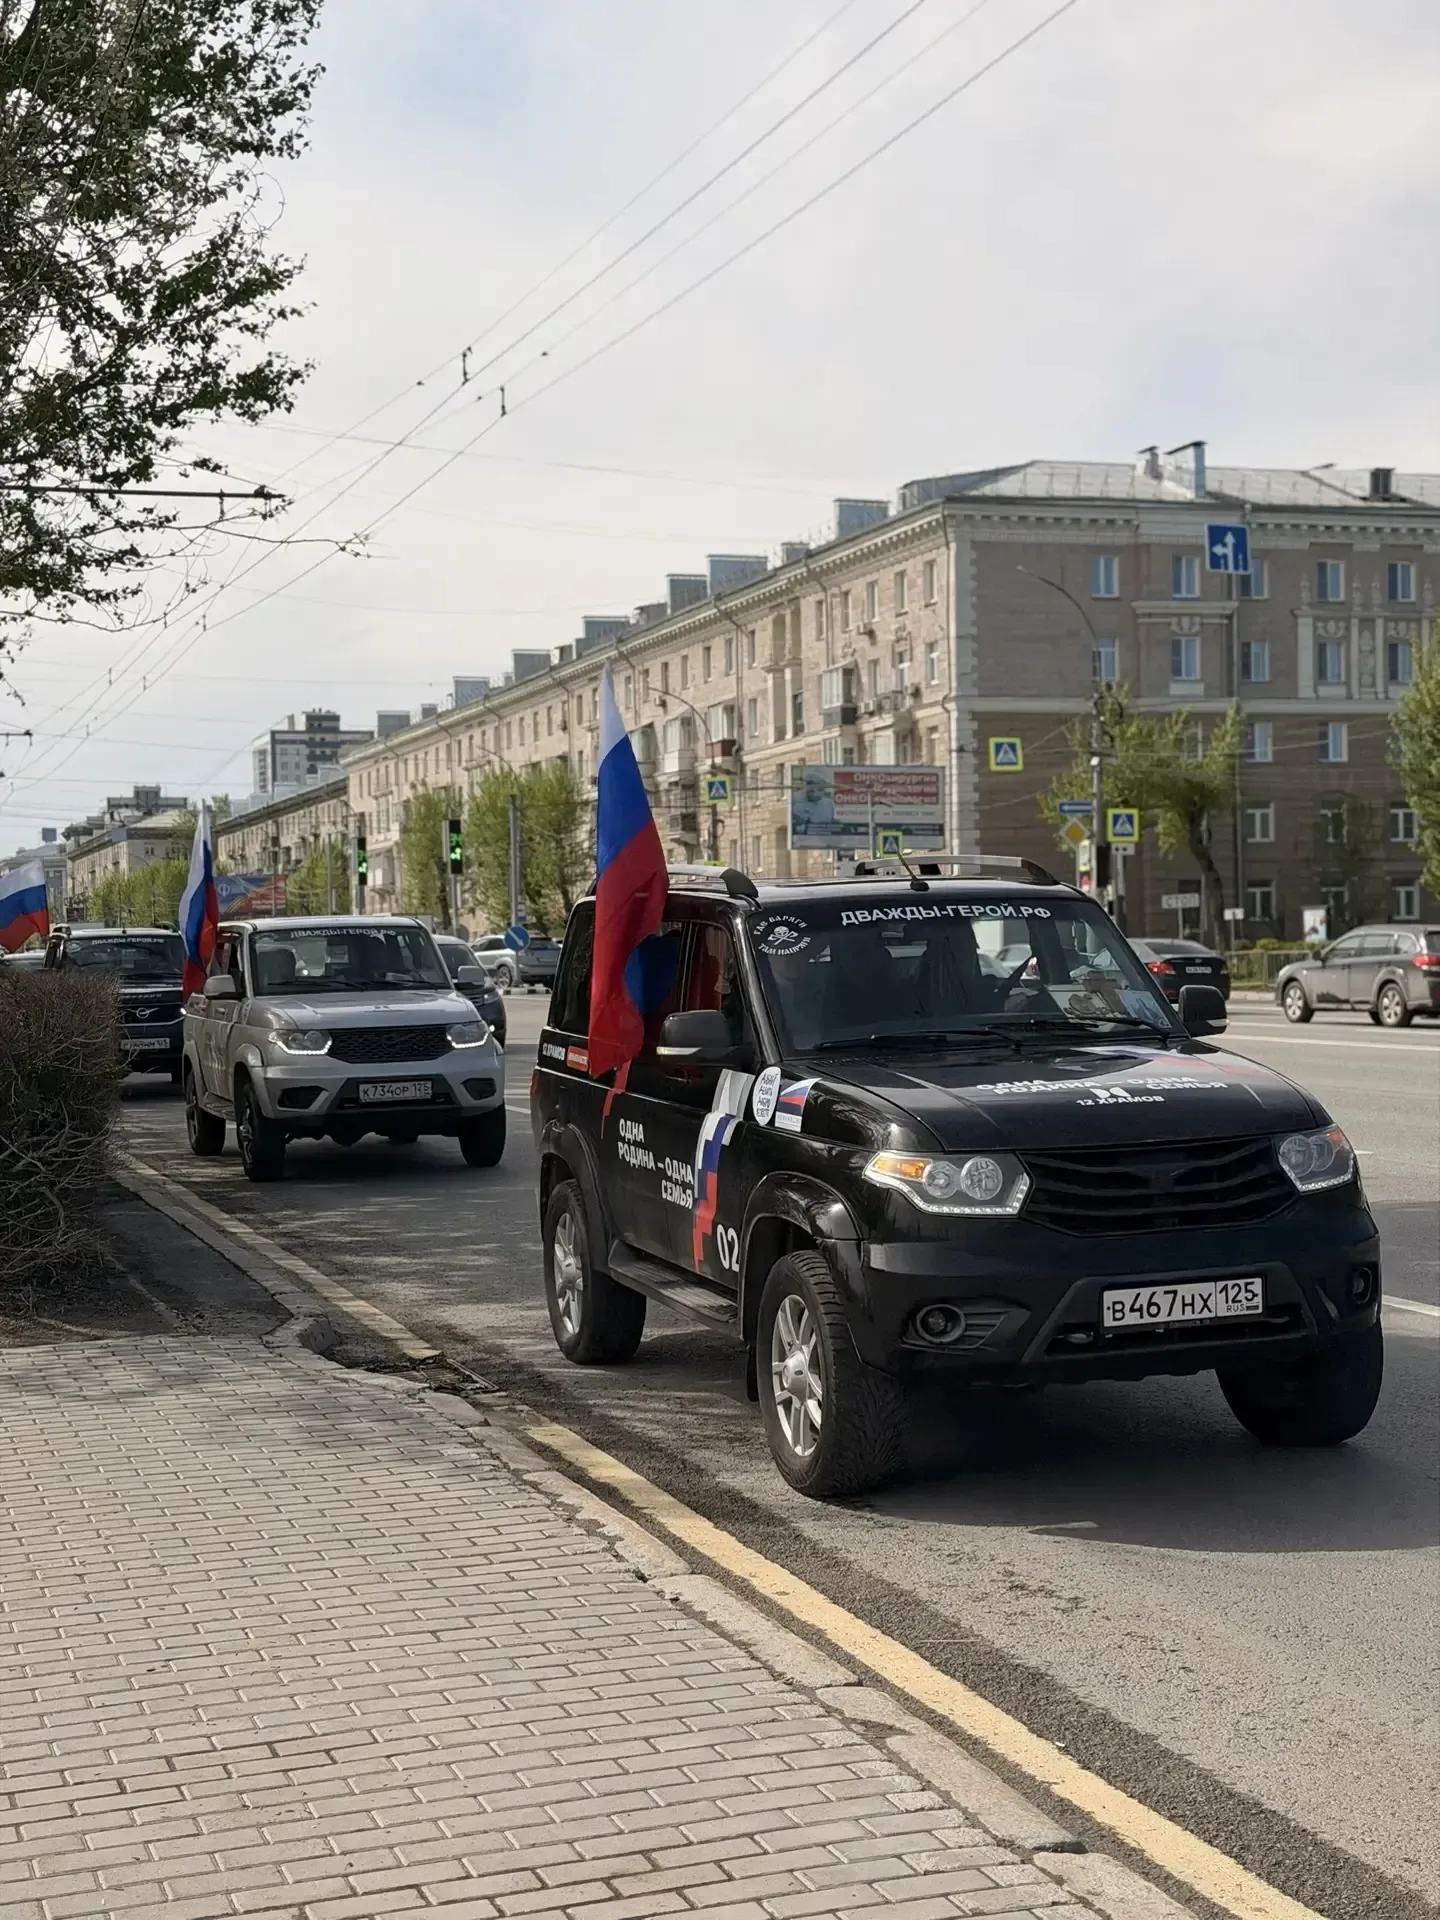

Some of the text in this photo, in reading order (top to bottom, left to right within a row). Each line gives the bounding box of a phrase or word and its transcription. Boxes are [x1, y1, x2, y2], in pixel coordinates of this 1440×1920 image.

[840, 902, 1051, 926] ДВАЖДЫ-ГЕРОЙ.РФ
[993, 1081, 1101, 1095] РОДИНА
[1127, 1076, 1199, 1085] ОДНА
[1145, 1082, 1228, 1090] СЕМЬЯ
[1096, 1095, 1165, 1105] ХРАМОВ
[619, 1118, 645, 1143] ОДНА
[617, 1141, 656, 1171] РОДИНА
[665, 1156, 694, 1185] ОДНА
[661, 1179, 693, 1209] СЕМЬЯ
[716, 1223, 740, 1272] 02
[1111, 1281, 1256, 1322] В467НХ 125
[1226, 1302, 1246, 1313] RUS
